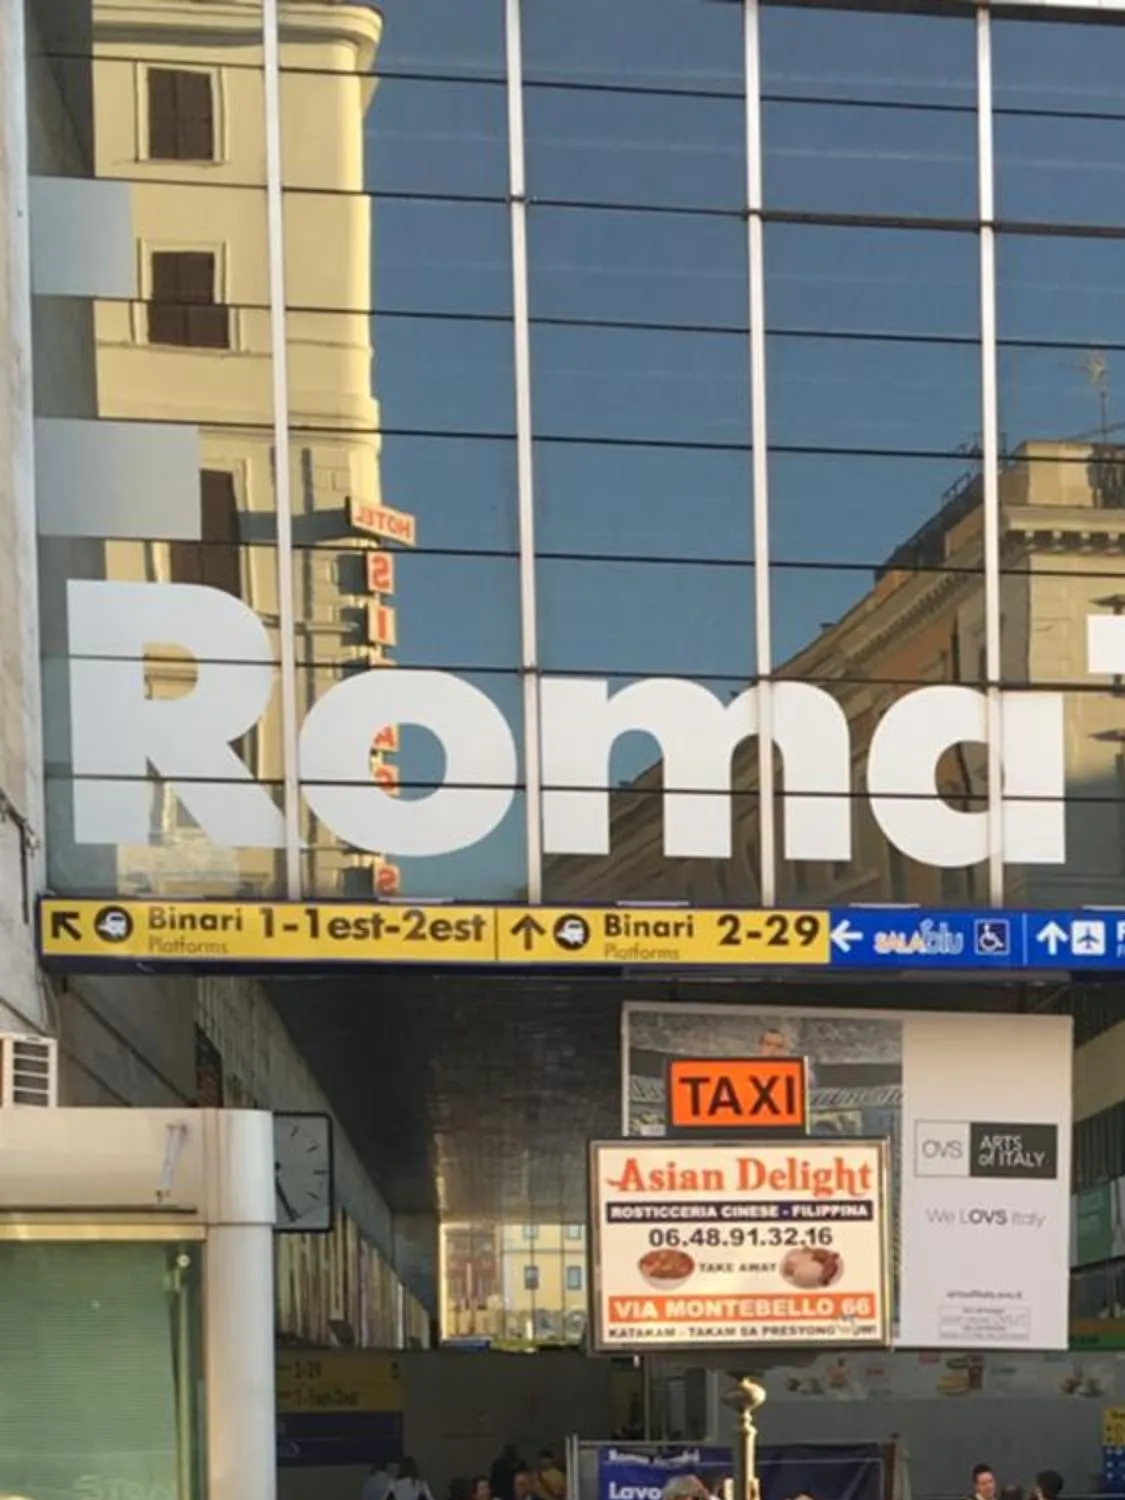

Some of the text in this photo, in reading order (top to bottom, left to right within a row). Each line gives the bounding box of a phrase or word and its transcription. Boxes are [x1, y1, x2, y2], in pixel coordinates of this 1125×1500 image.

[67, 579, 1066, 868] Roma
[148, 906, 486, 942] Binari 1-1est-2est
[604, 914, 820, 946] Binari 2-29
[148, 935, 228, 955] Platforms
[604, 943, 680, 961] Platforms
[678, 1074, 797, 1117] TAXI
[922, 1139, 963, 1159] OVS
[980, 1135, 1023, 1150] ARTS
[978, 1148, 1046, 1168] of ITALY
[606, 1156, 872, 1198] Asian Delight
[610, 1206, 718, 1220] ROSTICCERIA
[721, 1205, 779, 1219] CINESE
[792, 1204, 869, 1218] FILIPPINA
[925, 1208, 1047, 1228] We LOVS Italy
[649, 1227, 833, 1247] 06.48.91.32.16
[699, 1261, 776, 1273] TAKE AWAY
[614, 1300, 659, 1318] VIA
[666, 1298, 835, 1318] MONTEBELLO
